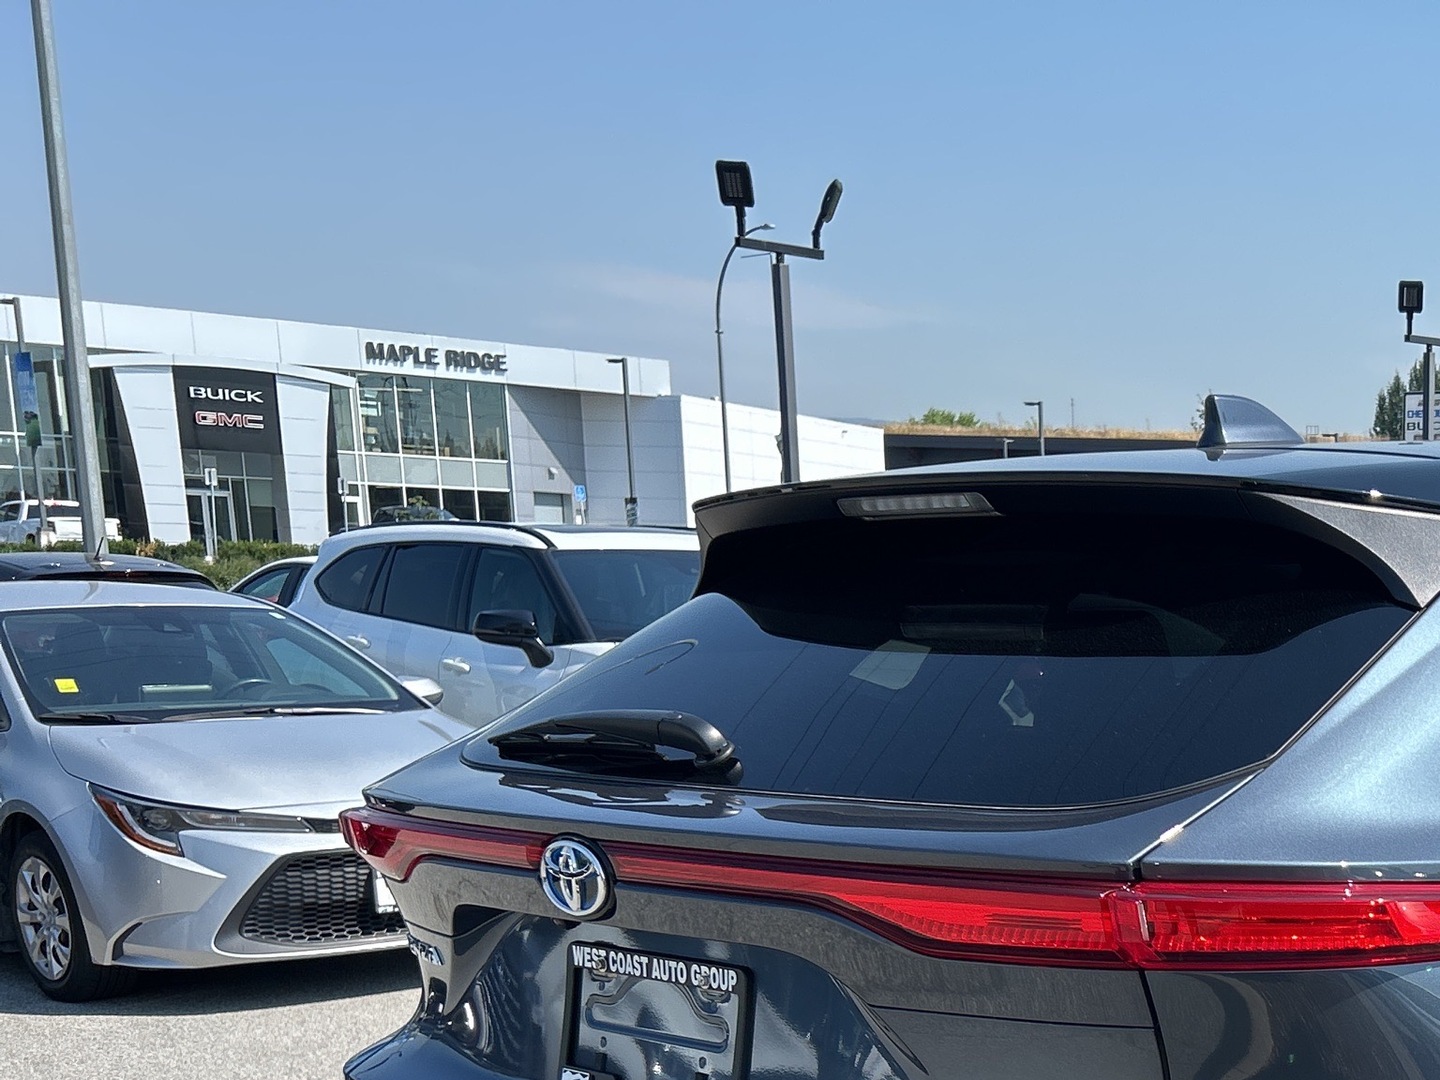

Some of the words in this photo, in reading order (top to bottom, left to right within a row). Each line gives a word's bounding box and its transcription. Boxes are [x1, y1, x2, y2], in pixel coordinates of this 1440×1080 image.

[365, 342, 440, 366] MAPLE
[445, 350, 508, 373] RIDGE
[189, 386, 264, 403] BUICK
[195, 411, 264, 429] GMC
[609, 951, 649, 977] COAST
[651, 958, 687, 984] AUTO
